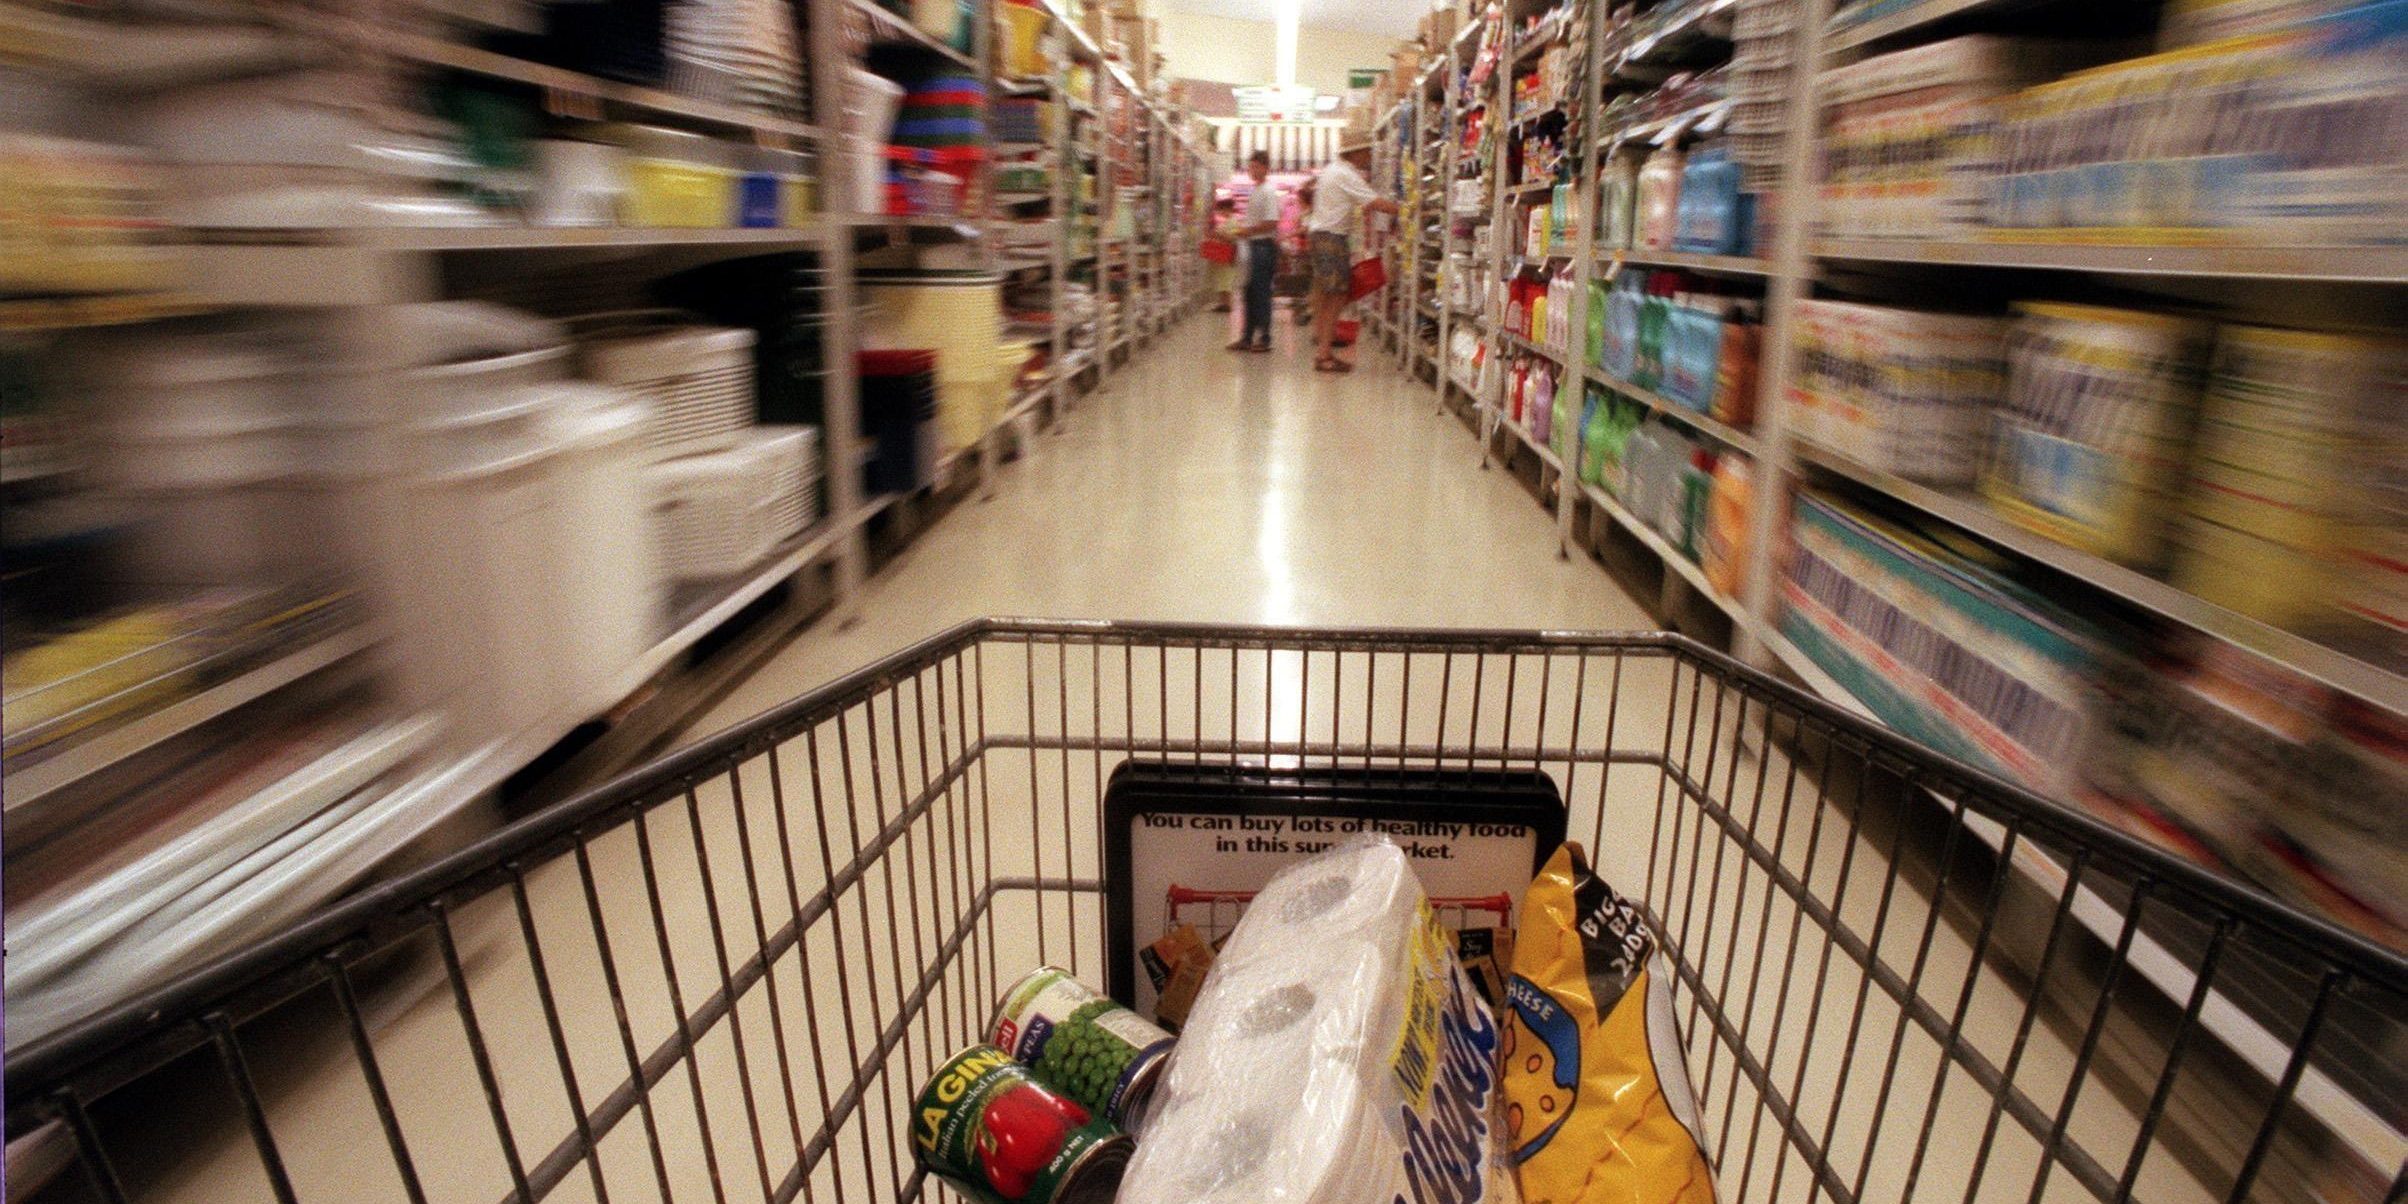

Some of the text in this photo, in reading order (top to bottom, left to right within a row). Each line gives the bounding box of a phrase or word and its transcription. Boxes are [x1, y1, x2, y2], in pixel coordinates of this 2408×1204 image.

[1139, 812, 1183, 828] You
[1190, 816, 1233, 831] can
[1240, 814, 1286, 834] buy
[1291, 815, 1335, 833] lots
[1372, 819, 1463, 841] healthy
[1468, 824, 1527, 838] food
[1216, 836, 1238, 852] in
[1246, 836, 1290, 853] this
[1608, 904, 1636, 939] BA
[1507, 981, 1554, 1020] HEESE
[956, 1079, 989, 1118] peeled
[917, 1106, 949, 1153] LA
